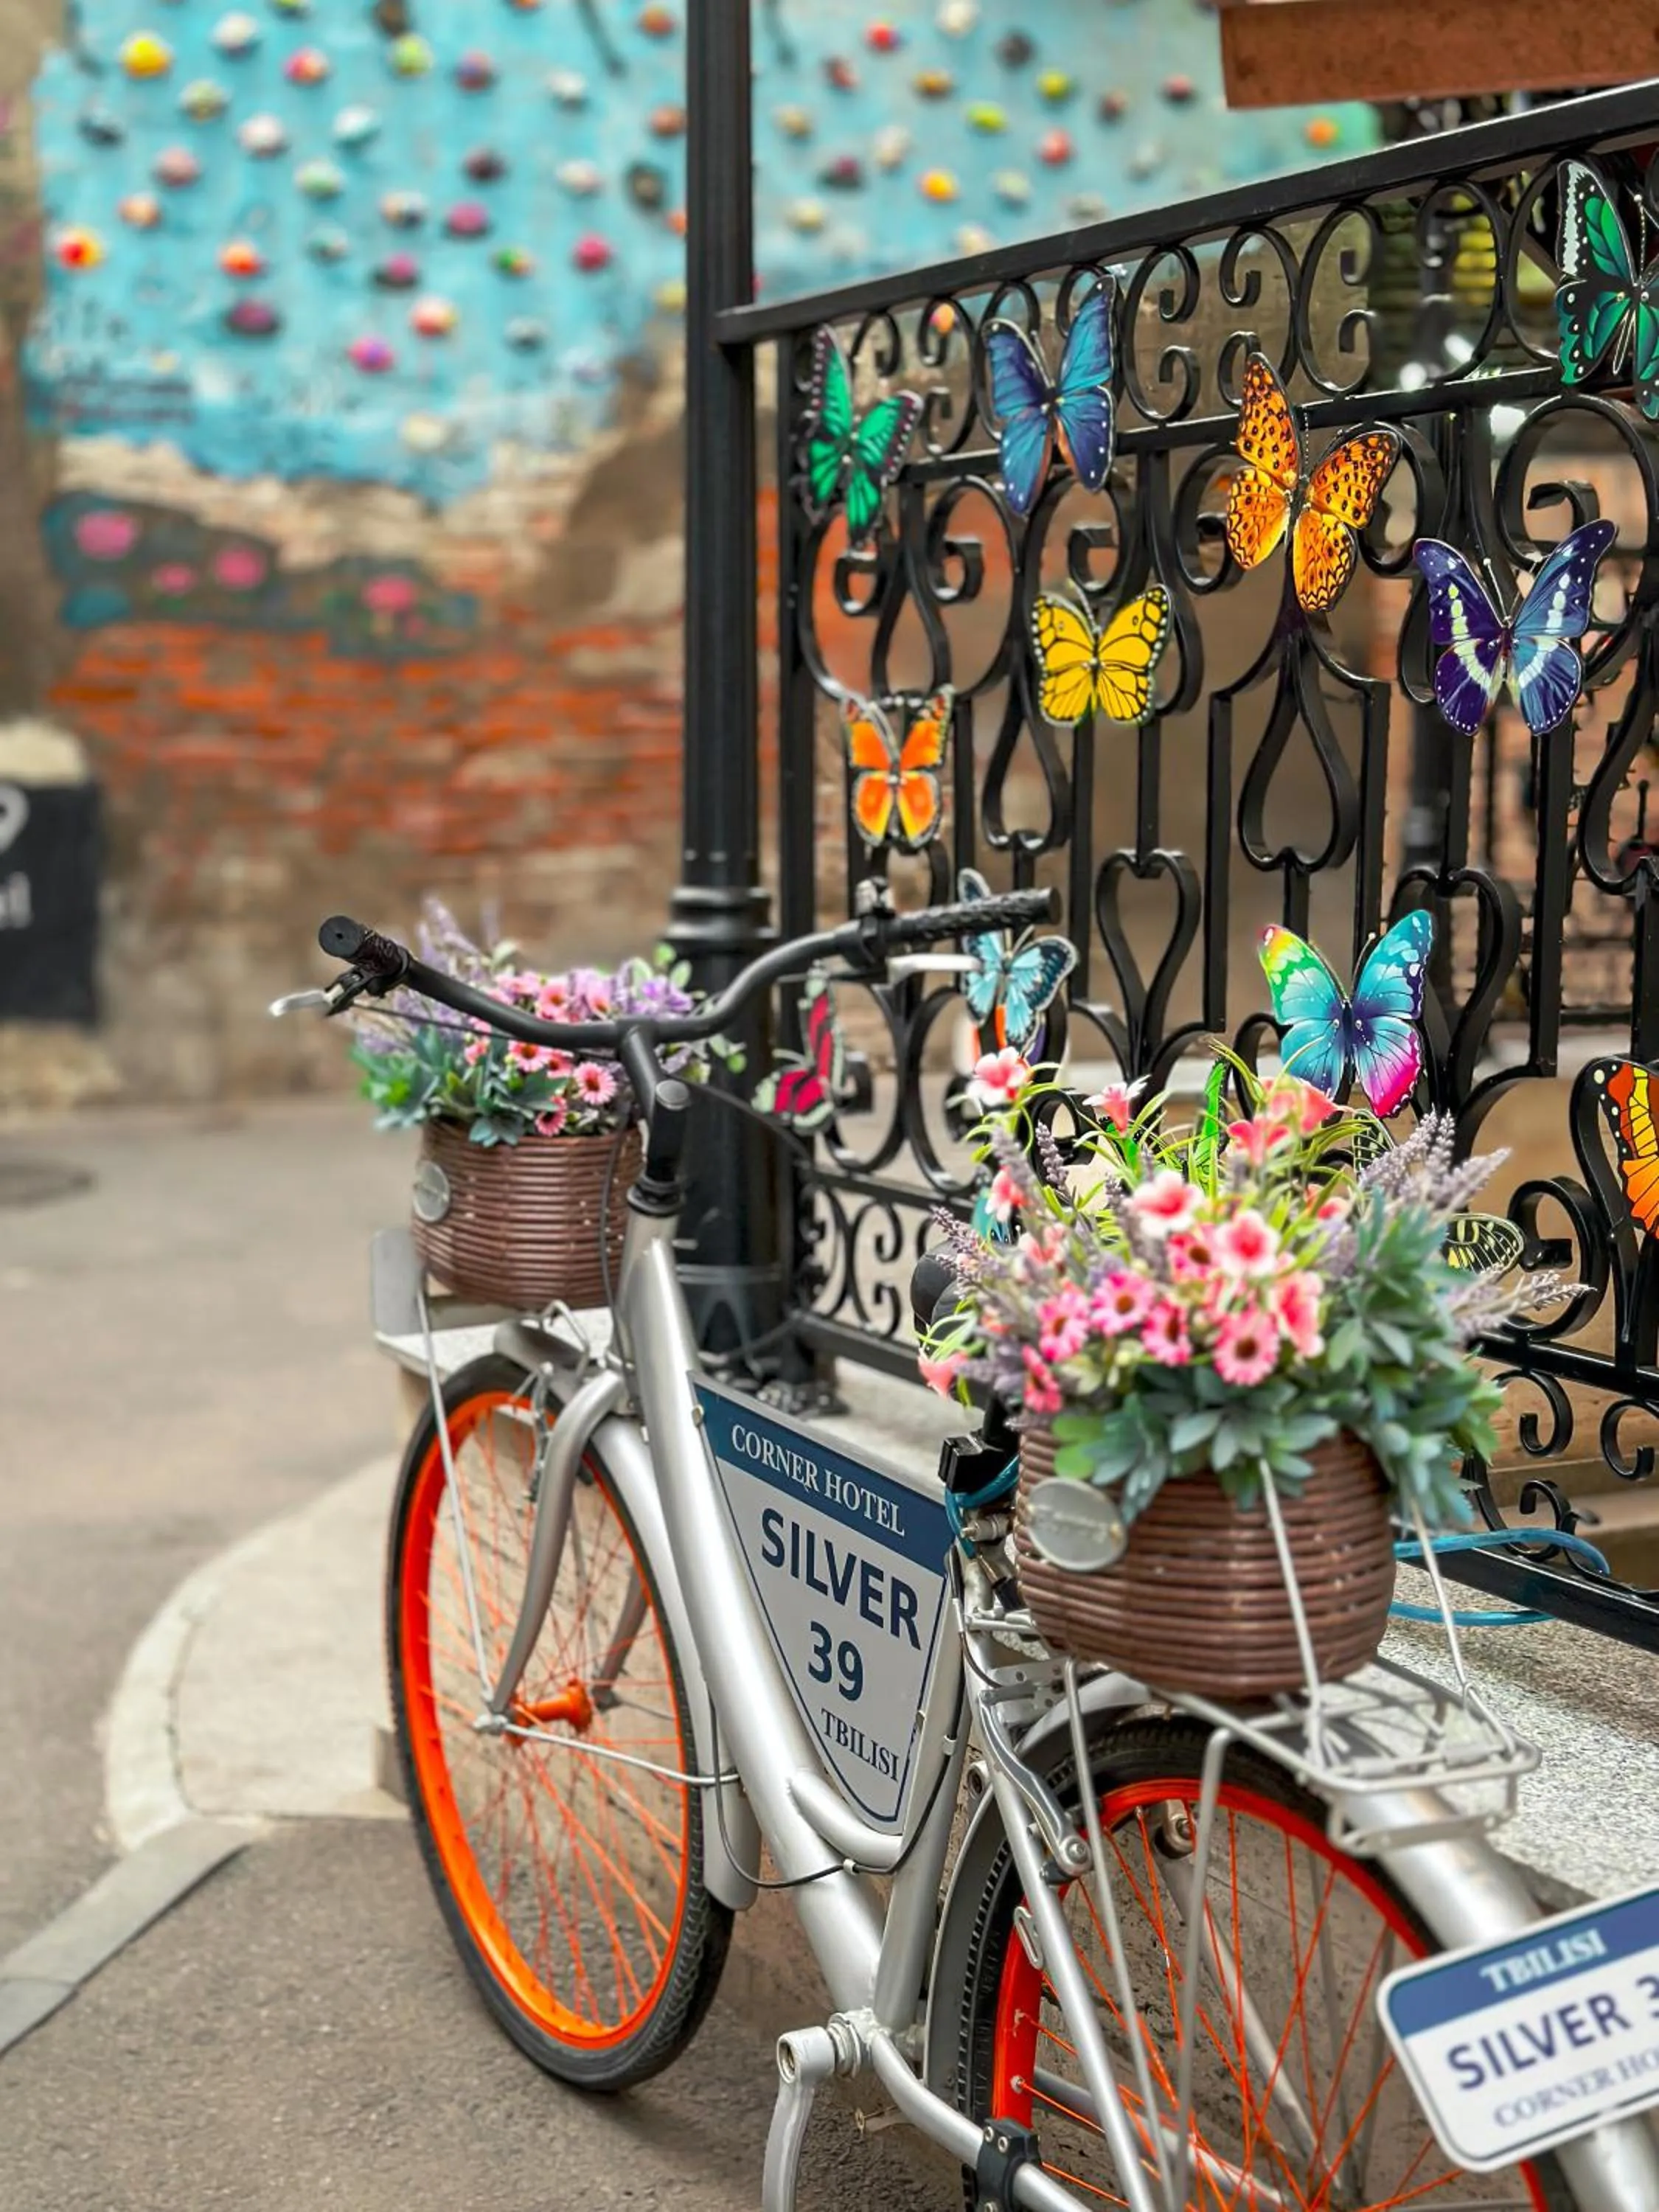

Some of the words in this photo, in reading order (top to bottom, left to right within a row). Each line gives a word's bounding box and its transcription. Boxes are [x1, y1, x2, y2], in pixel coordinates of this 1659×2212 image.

[731, 1424, 818, 1493] CORNER
[824, 1477, 905, 1537] HOTEL
[760, 1508, 922, 1650] SILVER
[808, 1621, 863, 1701] 39
[821, 1708, 899, 1782] TBILISI
[1480, 1928, 1607, 1992] TBILISI
[1447, 1993, 1632, 2090] SILVER
[1494, 2068, 1615, 2128] CORNER
